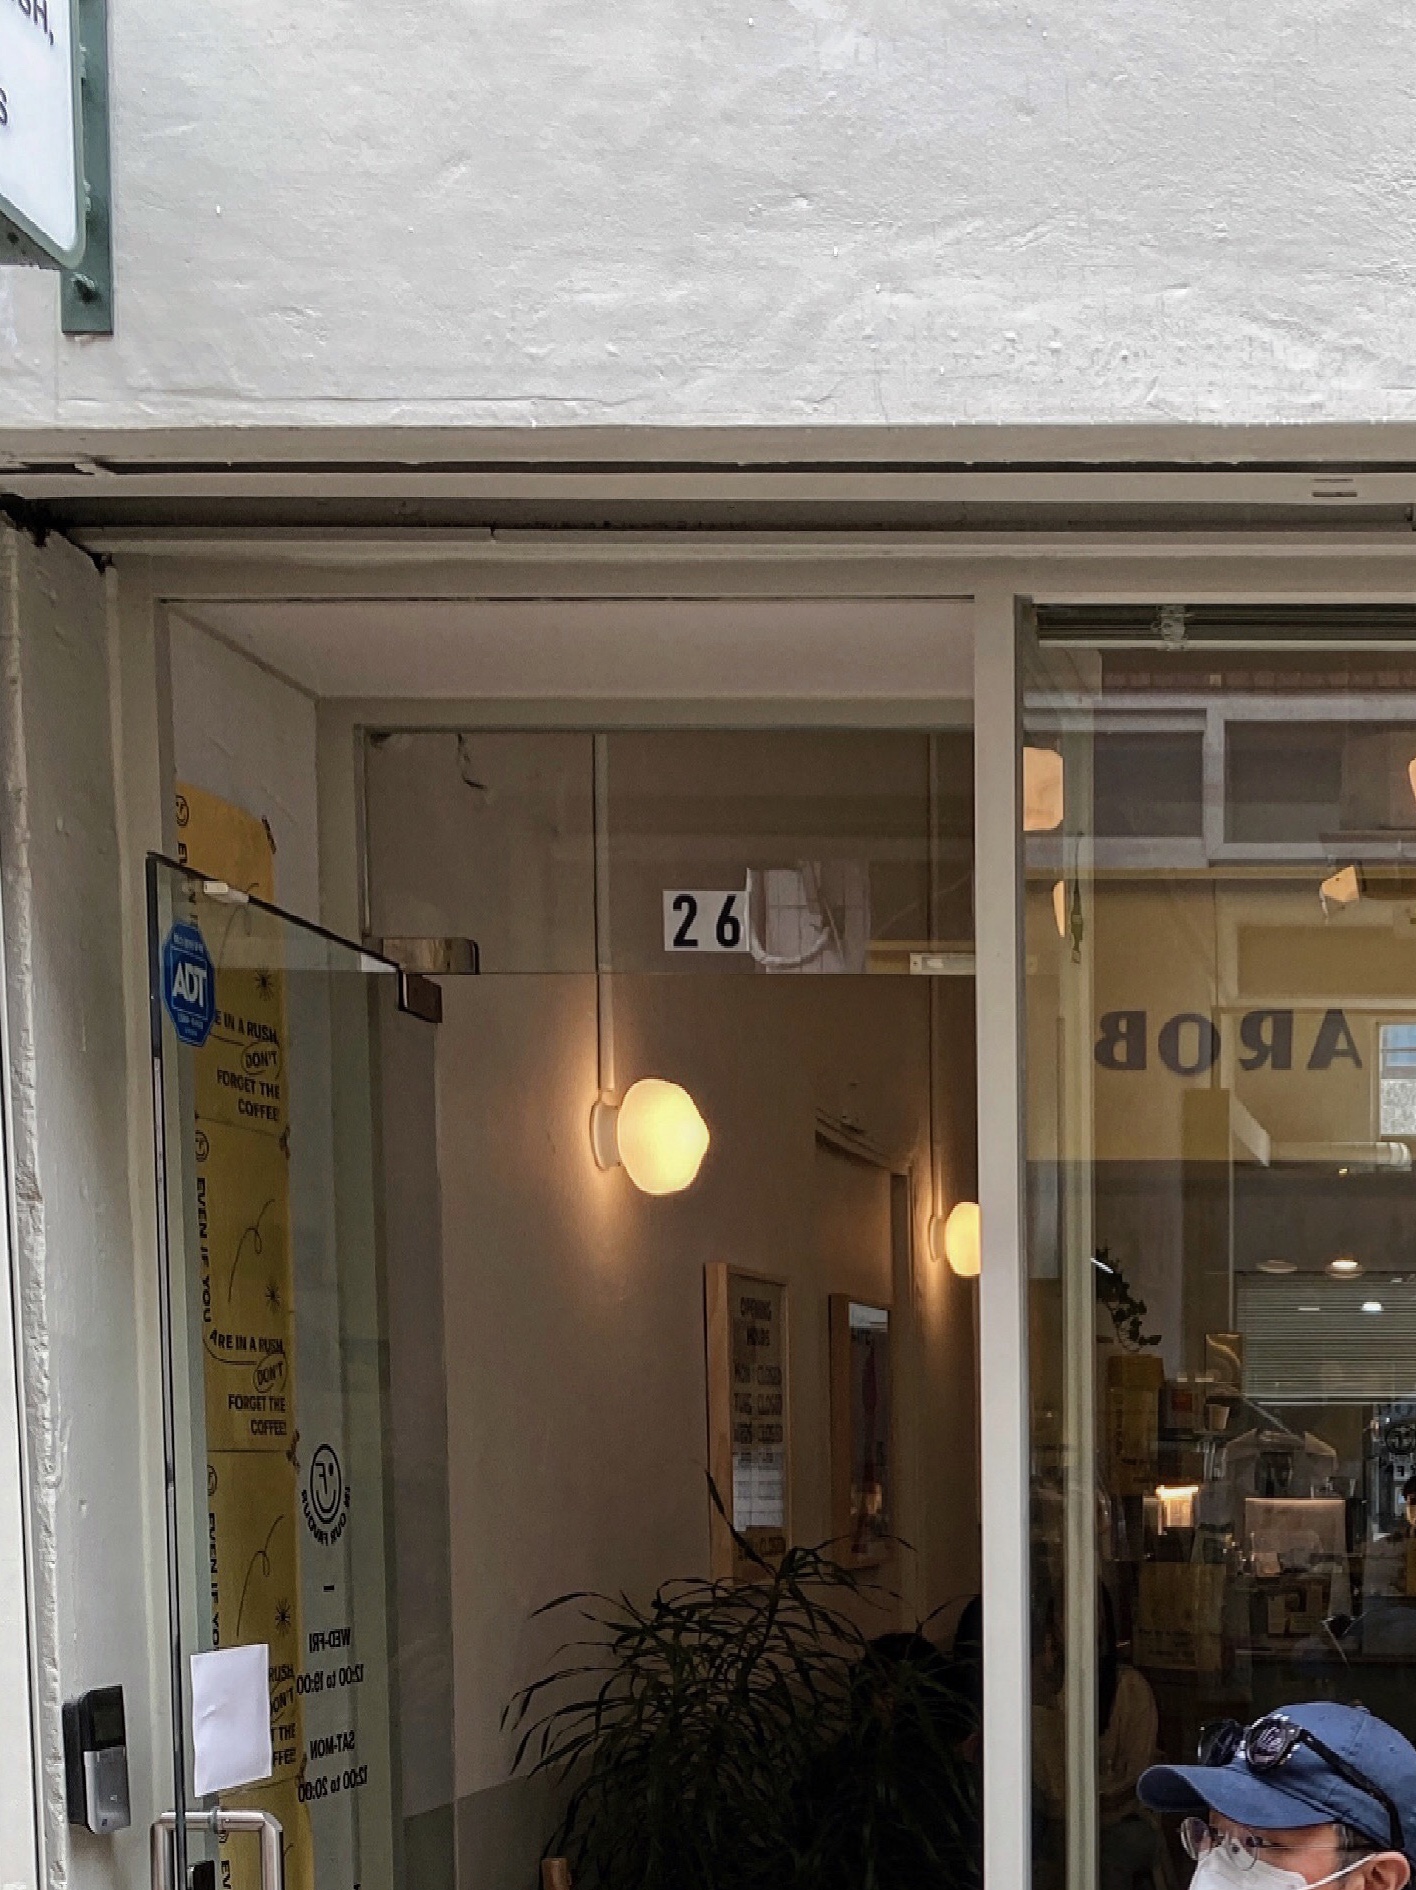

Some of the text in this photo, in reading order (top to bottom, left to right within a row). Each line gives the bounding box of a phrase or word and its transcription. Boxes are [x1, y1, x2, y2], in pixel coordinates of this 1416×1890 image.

[672, 893, 741, 949] 26
[172, 960, 207, 1008] ADT
[216, 1069, 280, 1100] FORGET THE
[209, 1328, 233, 1349] ARE
[228, 1393, 286, 1413] FORGET THE
[212, 1612, 220, 1651] YO
[270, 1687, 294, 1714] ON'T
